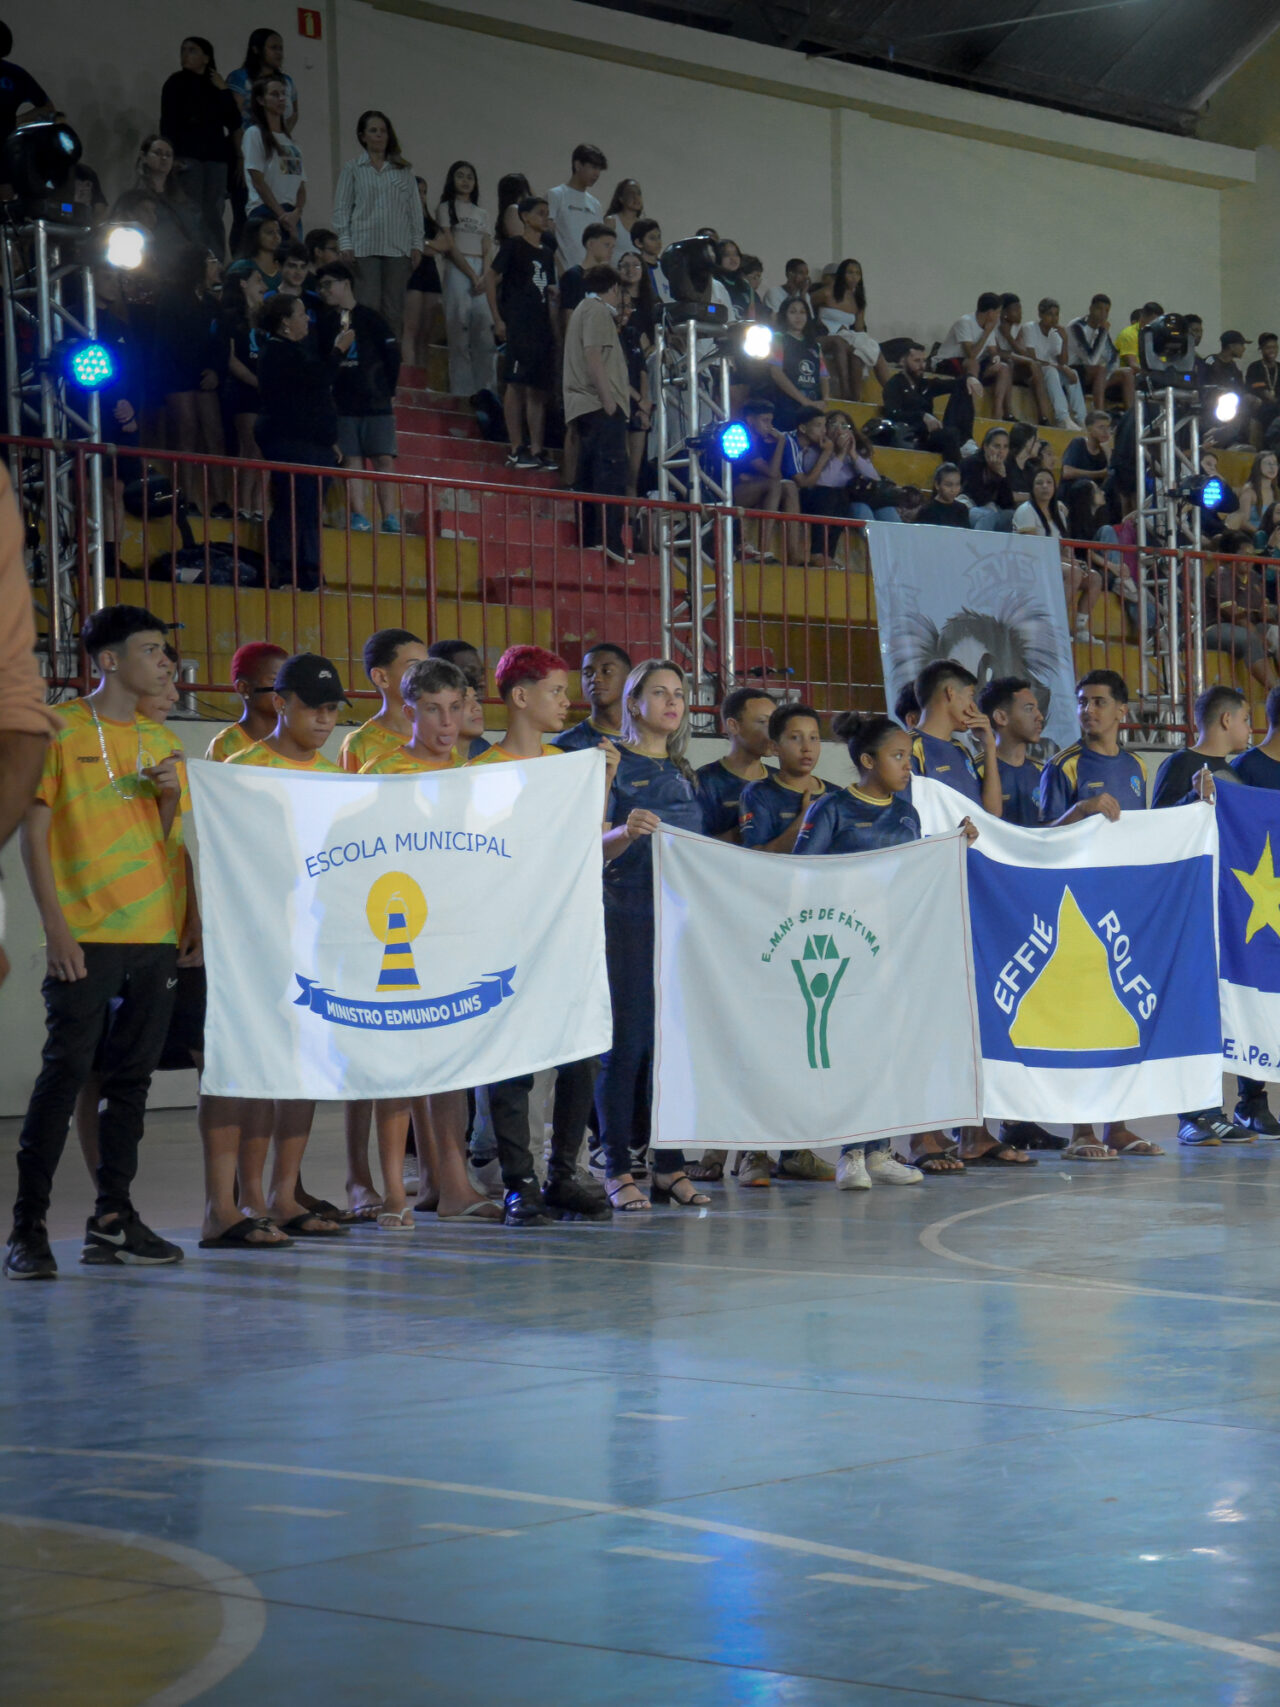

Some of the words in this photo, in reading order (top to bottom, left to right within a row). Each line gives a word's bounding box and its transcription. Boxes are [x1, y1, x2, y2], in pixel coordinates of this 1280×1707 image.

[305, 836, 387, 878] ESCOLA
[395, 831, 512, 859] MUNICIPAL
[818, 907, 835, 921] DE
[838, 909, 881, 958] FÁTIMA
[993, 912, 1054, 1015] EFFIE
[1097, 909, 1158, 1020] ROLFS
[326, 999, 383, 1025] MINISTRO
[385, 1006, 451, 1026] EDMUNDO
[452, 994, 482, 1017] LINS
[1248, 1044, 1272, 1067] Pe.
